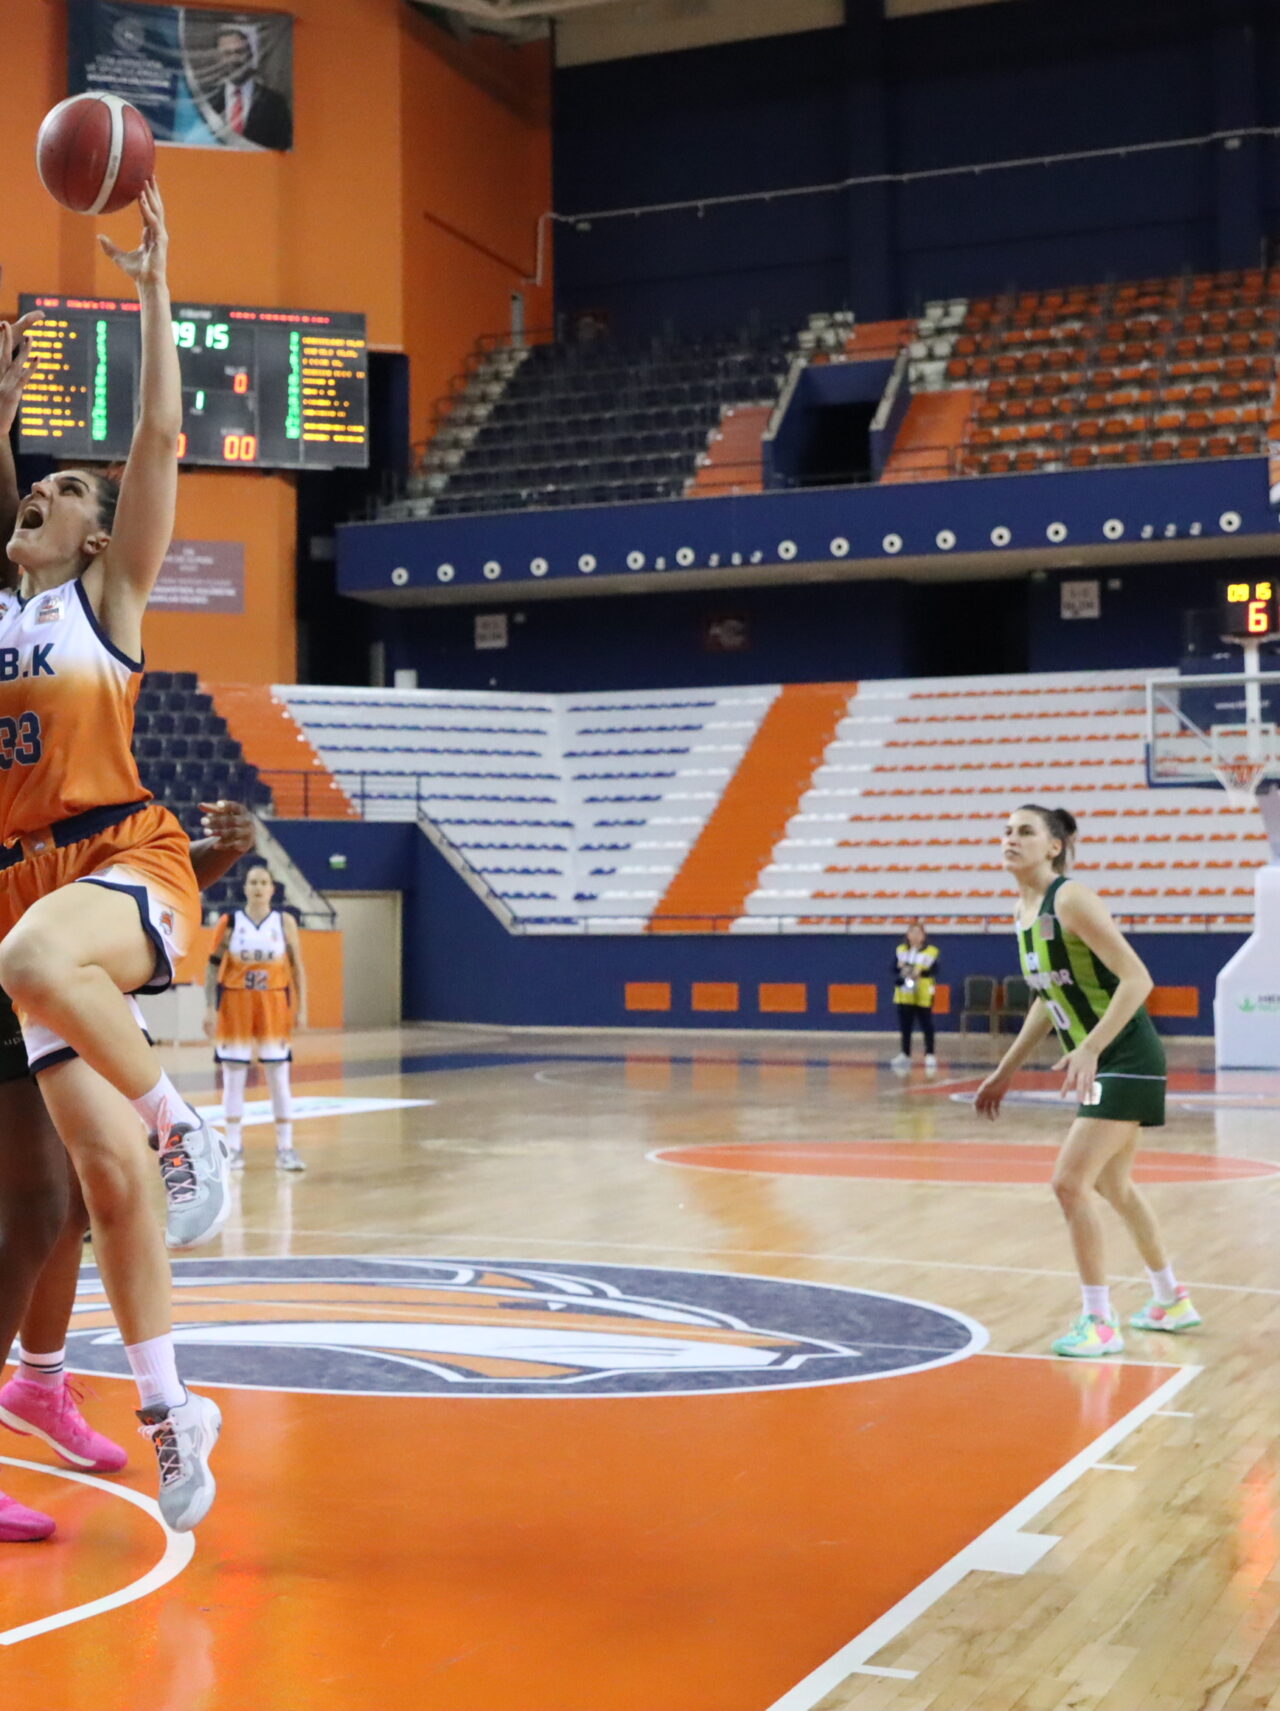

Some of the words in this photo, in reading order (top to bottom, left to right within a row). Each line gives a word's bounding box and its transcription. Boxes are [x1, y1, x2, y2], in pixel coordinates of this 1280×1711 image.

[205, 323, 230, 350] 15
[224, 435, 256, 461] 00
[1248, 601, 1268, 633] 6
